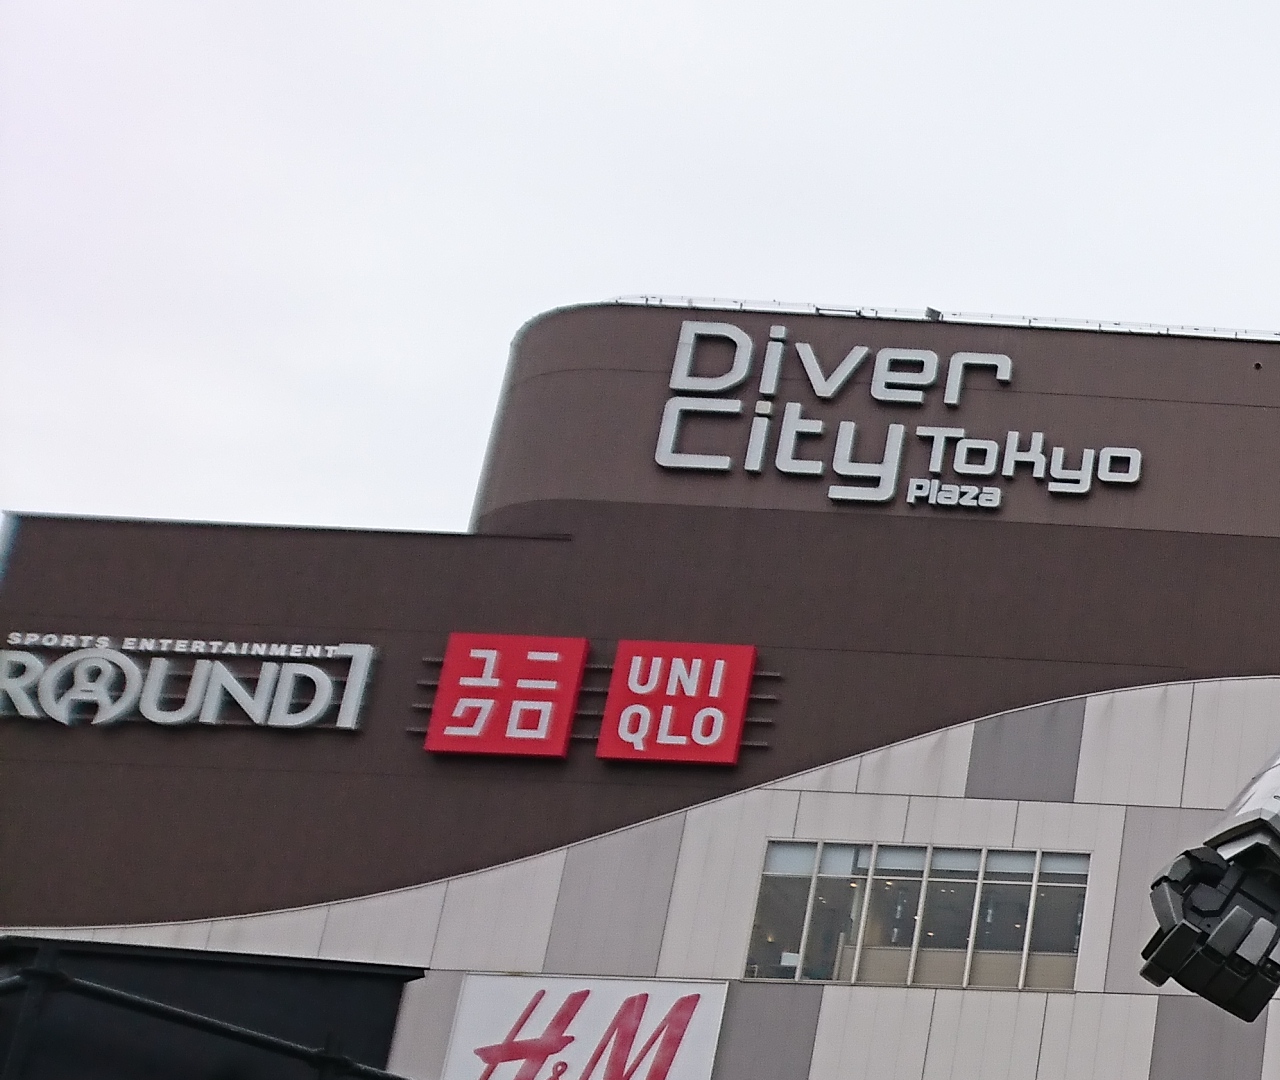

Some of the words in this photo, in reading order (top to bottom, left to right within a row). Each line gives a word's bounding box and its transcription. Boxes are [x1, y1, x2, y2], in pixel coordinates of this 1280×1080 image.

[669, 320, 1012, 406] Diver
[654, 396, 906, 502] City
[906, 478, 1003, 509] Plaza
[6, 631, 112, 649] SPORTS
[121, 637, 339, 659] ENTERTAINMENT
[458, 648, 560, 690] ユニ
[627, 654, 725, 698] UNI
[442, 697, 552, 740] クロ
[616, 702, 726, 752] QLO
